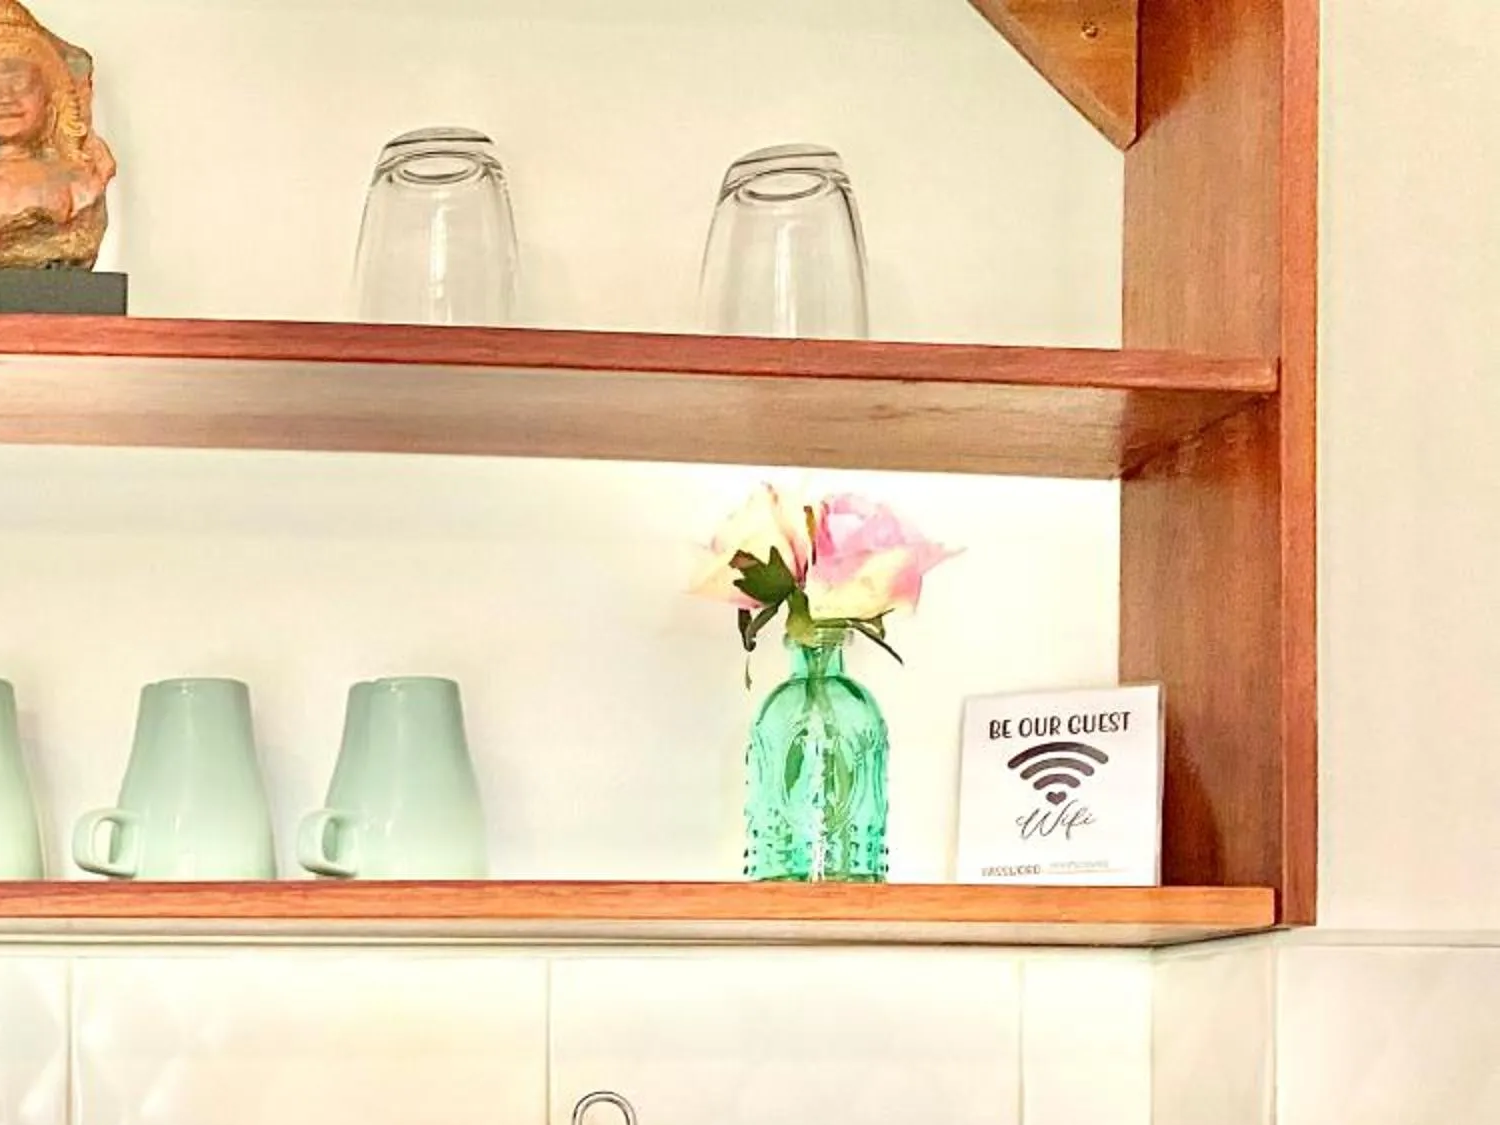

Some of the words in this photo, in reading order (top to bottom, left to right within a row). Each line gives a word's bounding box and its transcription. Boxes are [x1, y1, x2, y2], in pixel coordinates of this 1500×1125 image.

[989, 719, 1012, 739] BE
[1018, 715, 1061, 737] OUR
[1067, 711, 1131, 734] GUEST
